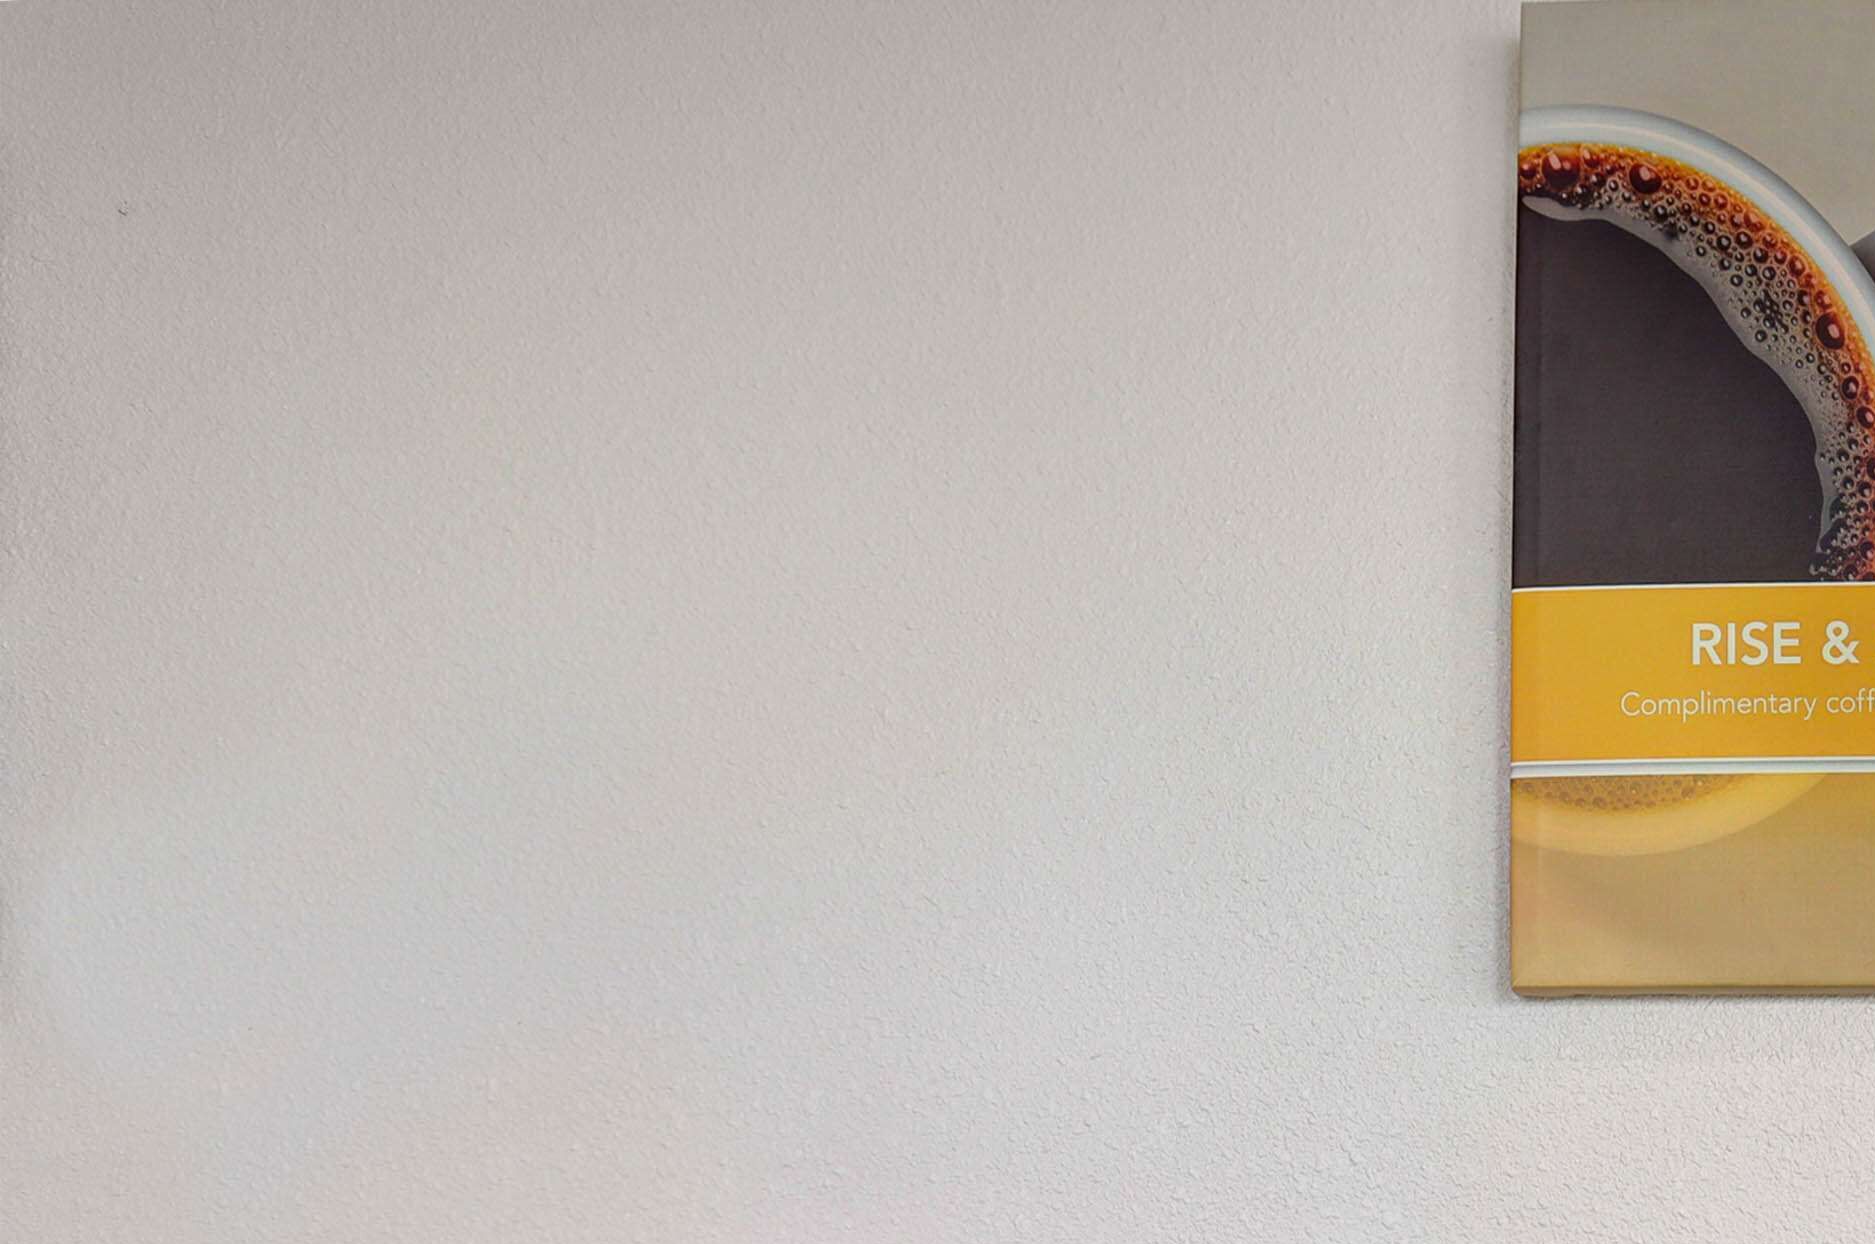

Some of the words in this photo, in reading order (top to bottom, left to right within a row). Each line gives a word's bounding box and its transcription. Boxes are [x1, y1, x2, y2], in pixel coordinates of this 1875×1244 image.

[1692, 621, 1802, 665] RISE
[1821, 620, 1860, 664] &
[1620, 689, 1817, 723] Complimentary
